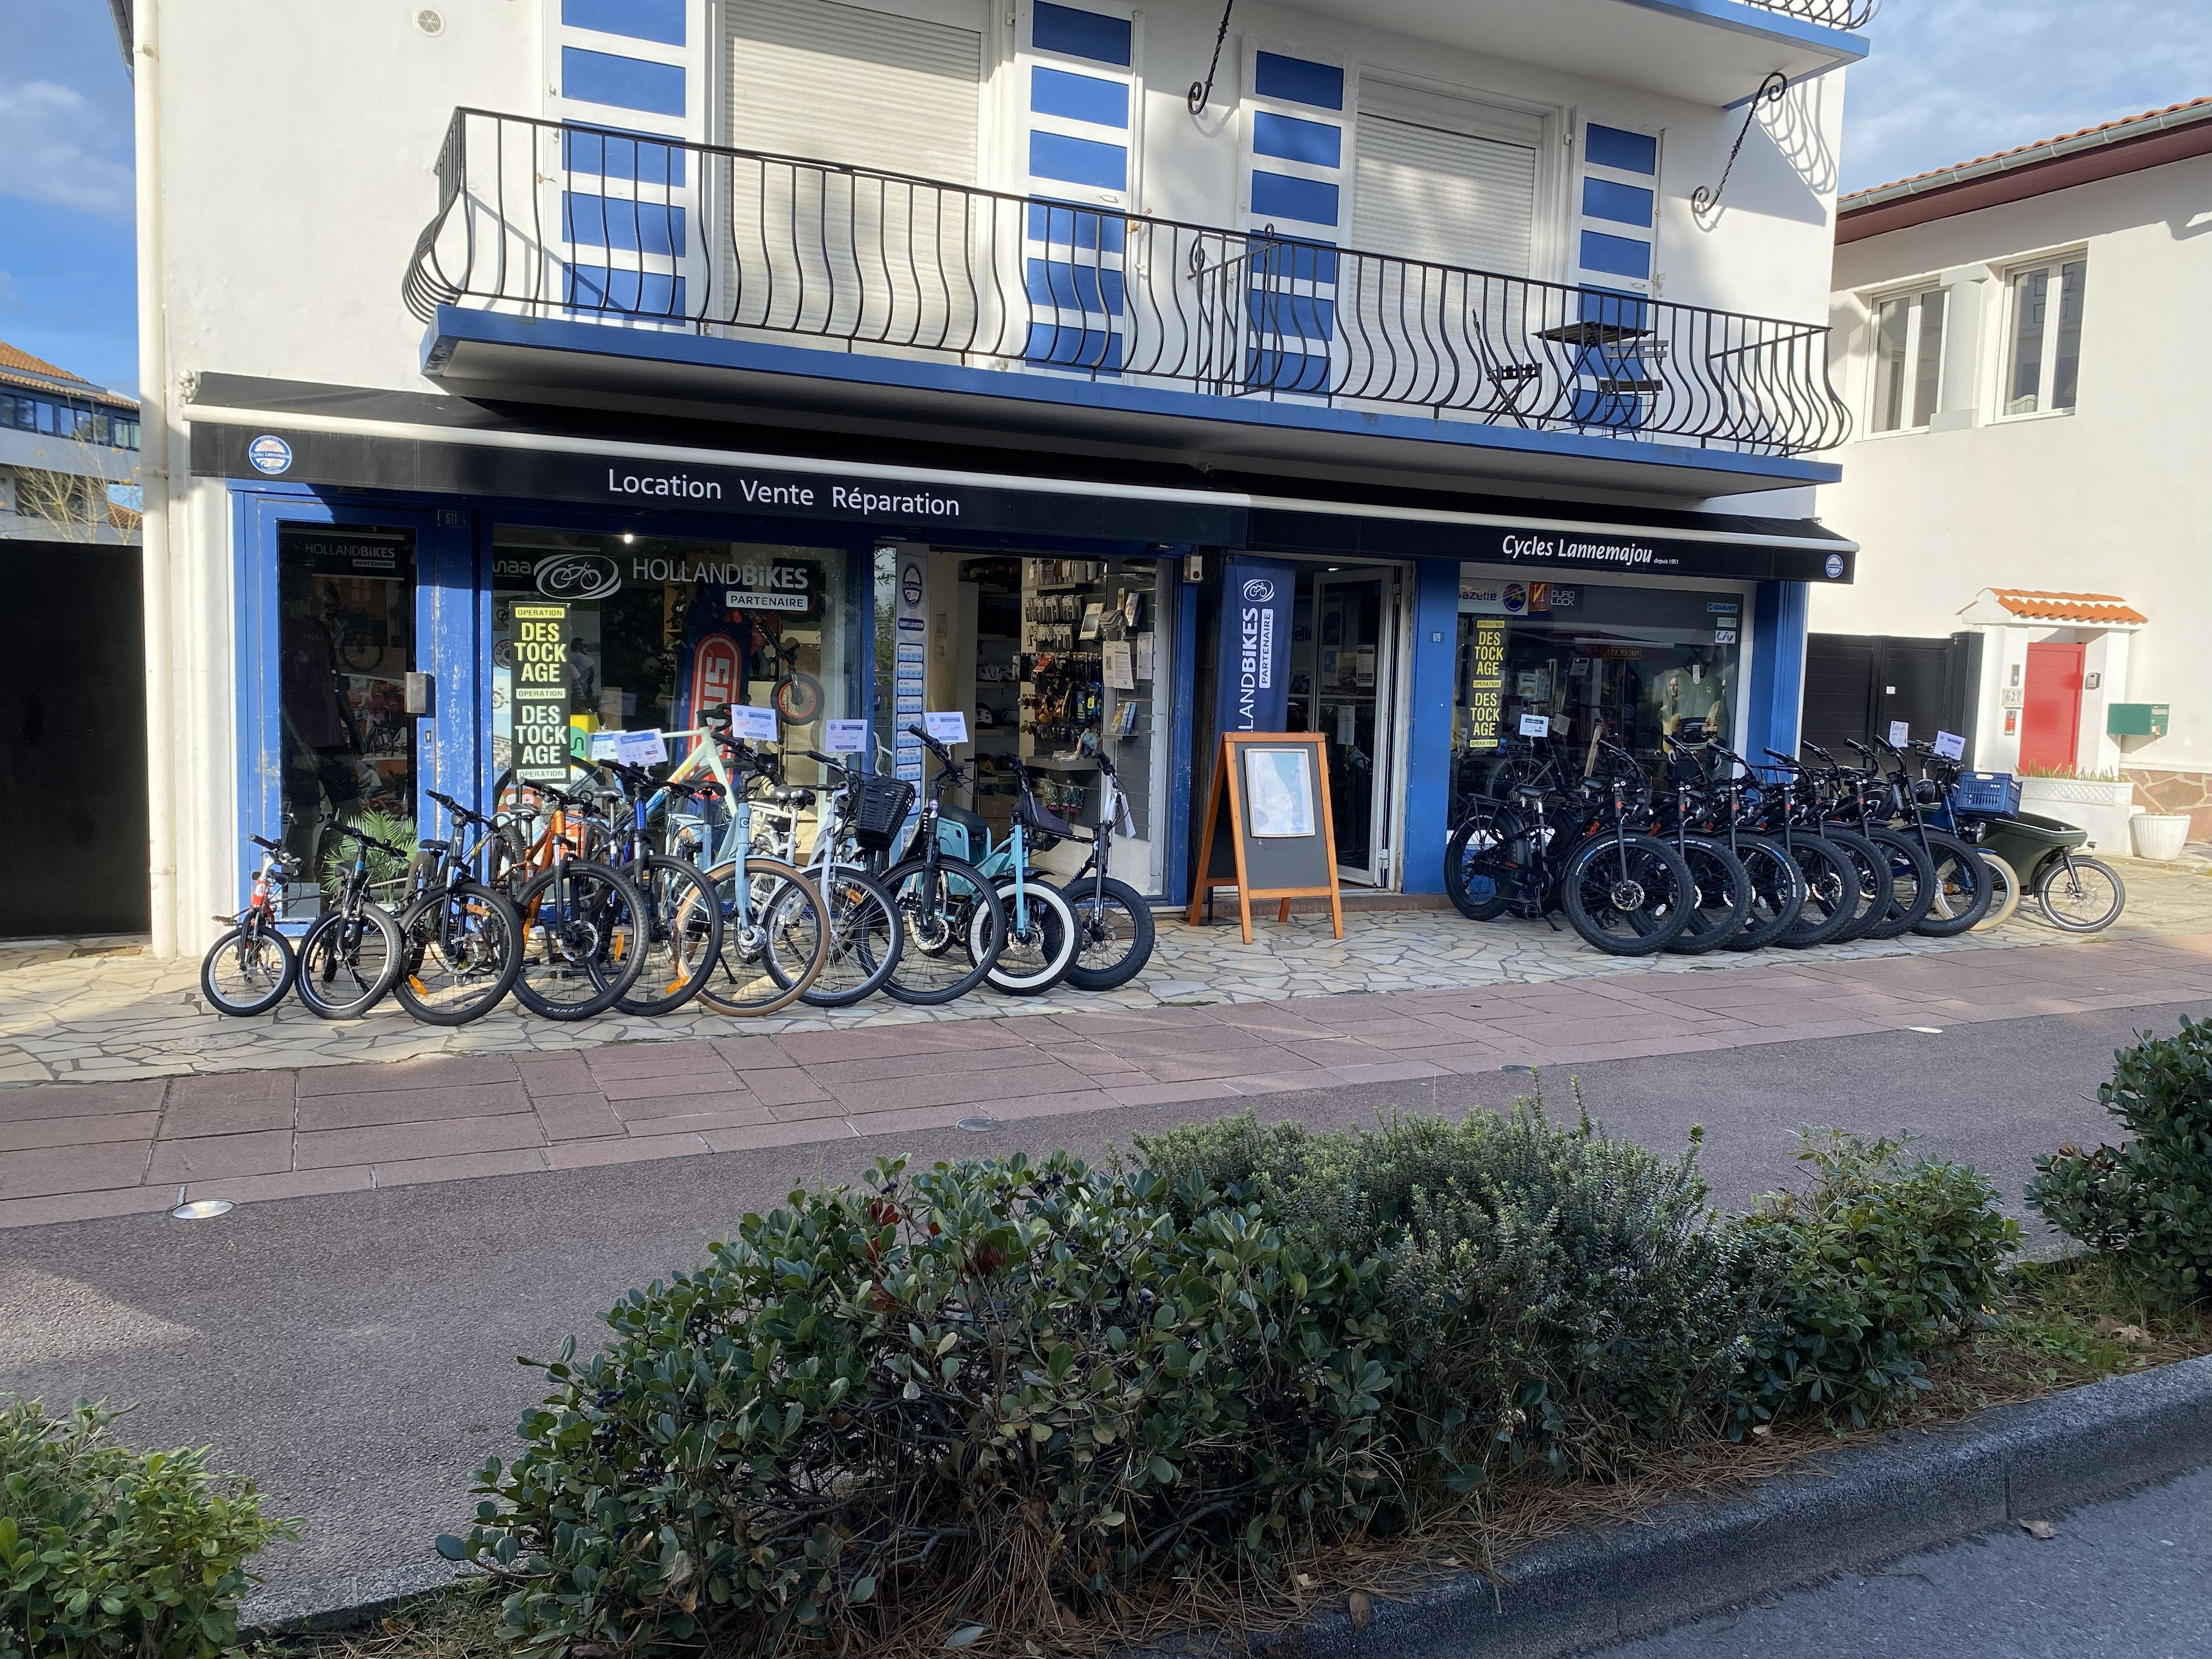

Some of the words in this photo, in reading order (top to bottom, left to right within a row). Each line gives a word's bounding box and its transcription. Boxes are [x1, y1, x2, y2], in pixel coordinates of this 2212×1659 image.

[609, 469, 721, 499] Location
[740, 479, 814, 505] Vente
[832, 486, 960, 516] Réparation
[446, 512, 458, 525] 611
[1503, 535, 1554, 558] Cycles
[1558, 539, 1652, 566] Lannemajou
[731, 595, 804, 607] PARTENAIRE
[1550, 597, 1575, 606] LOCK
[1551, 590, 1575, 599] QUAD
[521, 622, 560, 642] DES
[1479, 631, 1501, 646] DES
[1717, 631, 1734, 641] Liv
[514, 642, 567, 662] TOCK
[1262, 613, 1271, 684] PARTENAIRE
[1474, 646, 1504, 661] TOCK
[521, 663, 560, 682] AGE
[1476, 662, 1499, 675] AGE
[1475, 692, 1497, 707] DES
[2006, 692, 2021, 702] 627
[522, 705, 560, 724] DES
[1470, 707, 1500, 721] TOCK
[514, 725, 567, 744] TOCK
[1473, 722, 1496, 736] AGE
[522, 746, 561, 764] AGE
